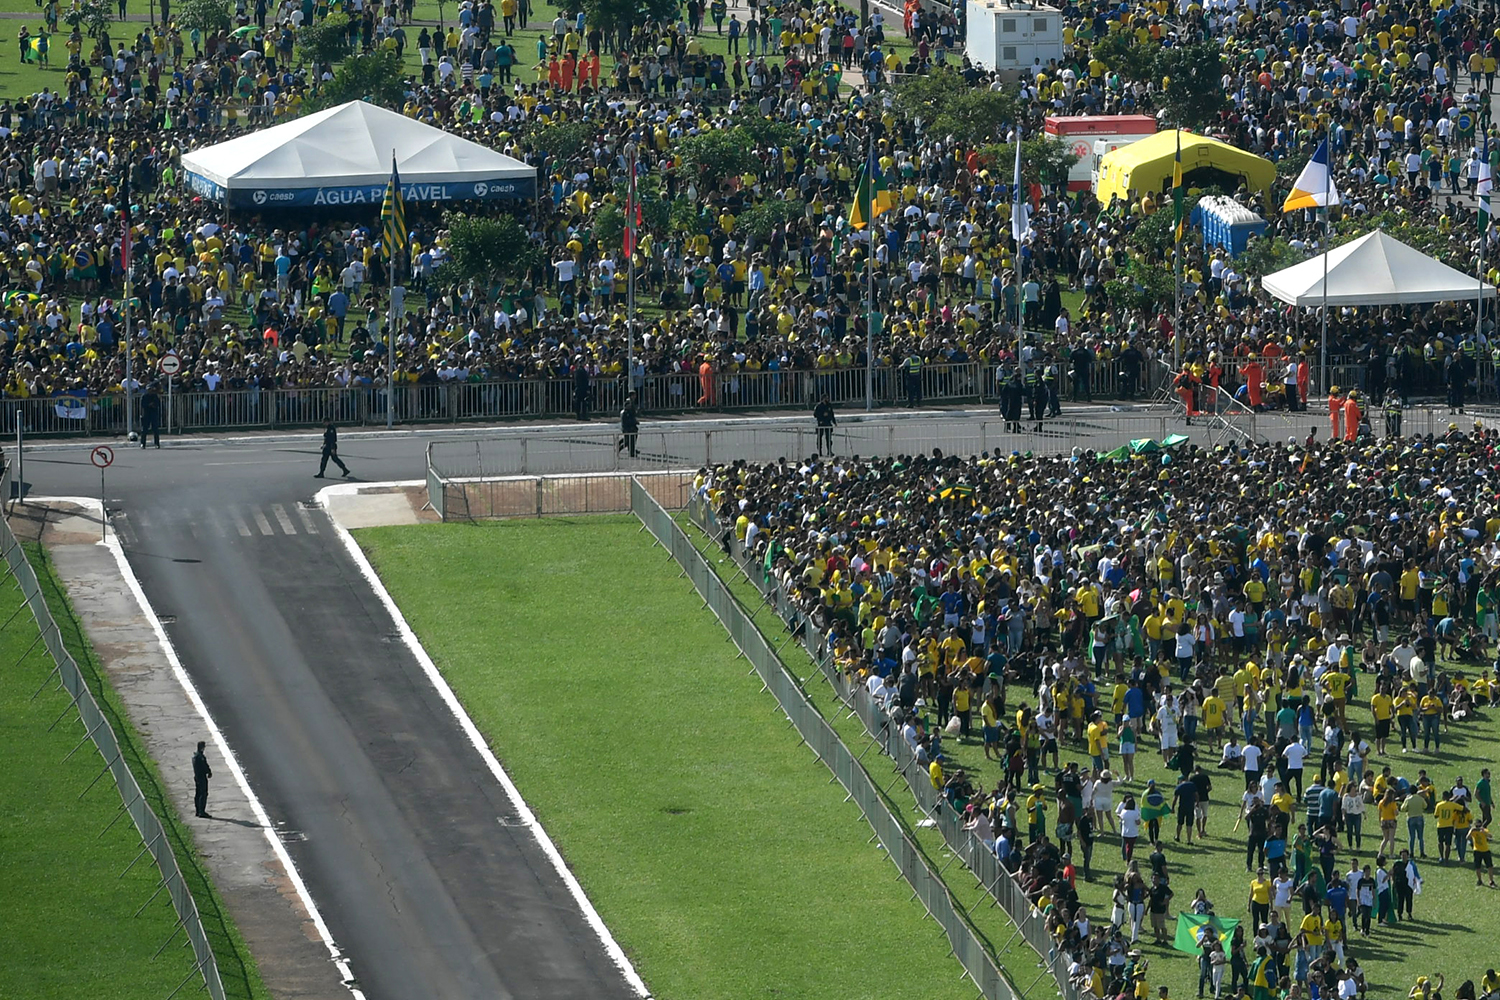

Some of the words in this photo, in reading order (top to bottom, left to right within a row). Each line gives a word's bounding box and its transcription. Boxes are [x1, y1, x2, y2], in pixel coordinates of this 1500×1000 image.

[269, 192, 294, 201] caesb
[313, 187, 366, 205] ÁGUA
[1442, 808, 1451, 819] 10
